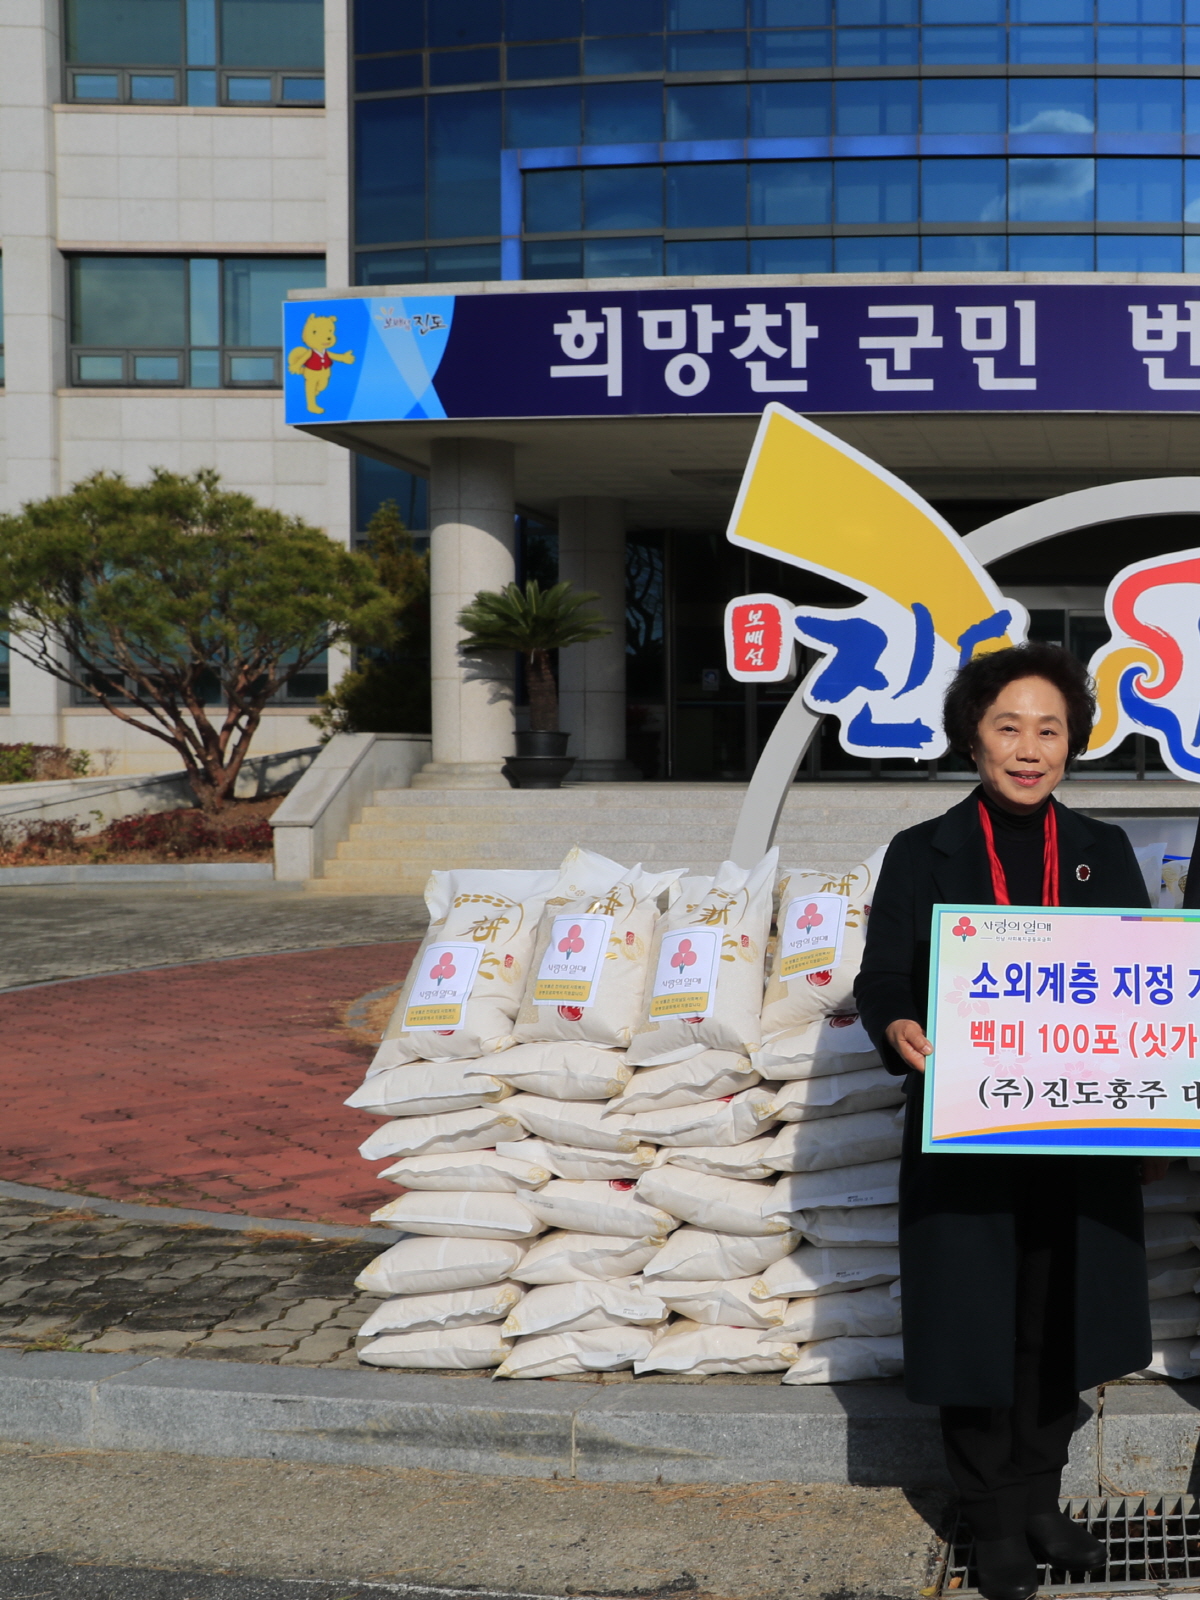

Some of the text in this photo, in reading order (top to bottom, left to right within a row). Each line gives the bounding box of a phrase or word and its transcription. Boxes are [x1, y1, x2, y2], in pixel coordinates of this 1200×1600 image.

[413, 314, 447, 335] 진도
[550, 303, 818, 397] 희망찬
[859, 301, 1036, 392] 군민
[744, 609, 765, 667] 보배섬
[981, 918, 1052, 935] 사랑의 열매
[969, 962, 1099, 1004] 소외계층
[1113, 963, 1174, 1005] 지정
[970, 1020, 1025, 1057] 백미
[1039, 1023, 1120, 1055] 100포
[1129, 1023, 1198, 1059] (싯가
[979, 1076, 1168, 1110] (주)진도홍주
